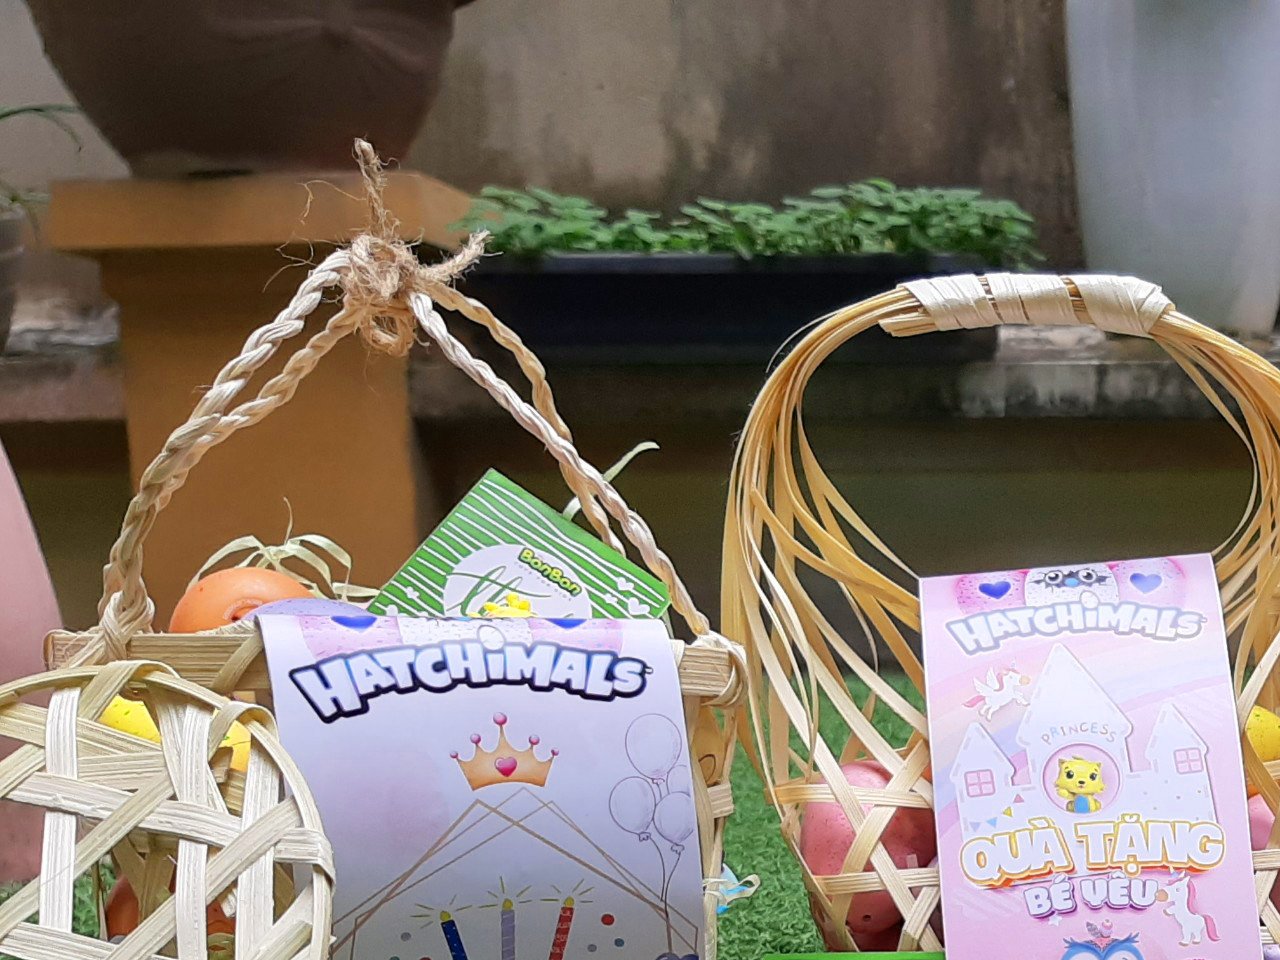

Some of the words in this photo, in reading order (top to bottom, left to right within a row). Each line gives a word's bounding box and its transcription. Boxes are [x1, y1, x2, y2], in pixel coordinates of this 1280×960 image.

[1041, 722, 1116, 744] PRINCESS
[960, 817, 1074, 887] QUÀ
[1073, 814, 1225, 877] TẶNG
[1023, 873, 1077, 919] BÉ
